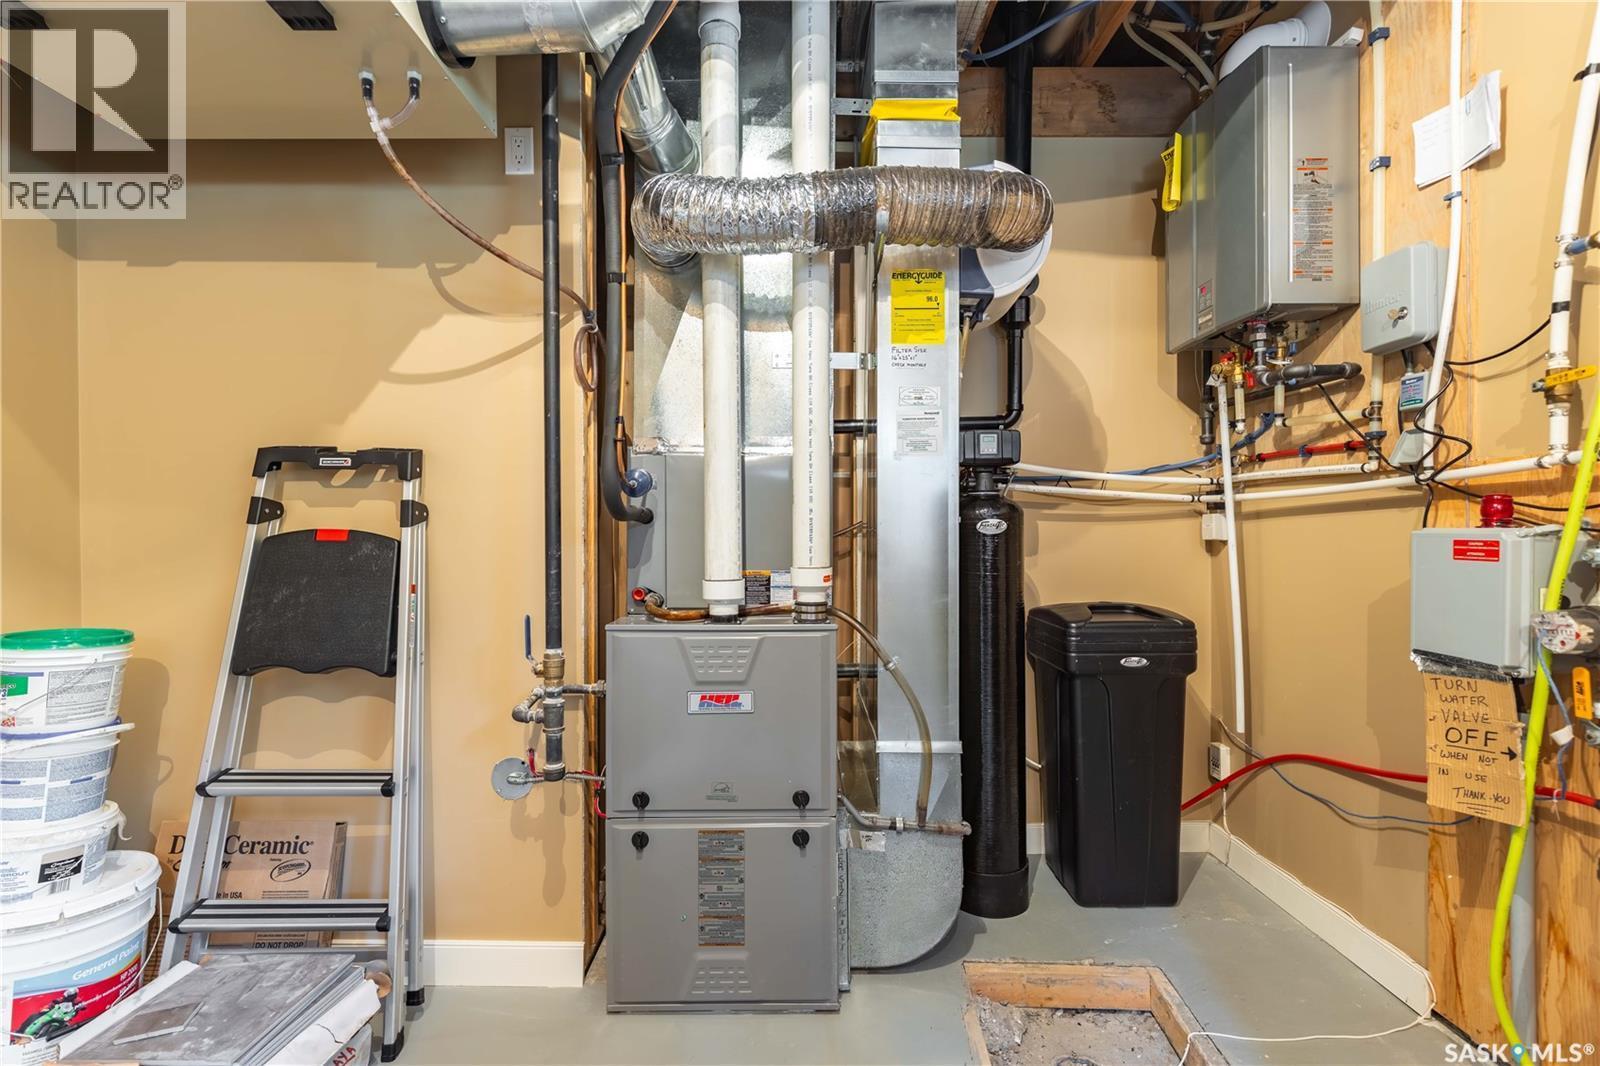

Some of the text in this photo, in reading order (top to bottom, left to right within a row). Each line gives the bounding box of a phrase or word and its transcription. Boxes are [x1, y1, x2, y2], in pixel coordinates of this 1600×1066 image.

[891, 272, 943, 282] ENERGYGUIDE
[1430, 677, 1478, 693] TURN
[1440, 694, 1488, 707] WATER
[1441, 708, 1491, 724] VALVE
[1445, 726, 1499, 747] OFF
[1440, 750, 1499, 767] WHEN NOT
[1438, 767, 1488, 783] IN USE
[1452, 786, 1487, 801] THANK
[72, 954, 119, 981] General
